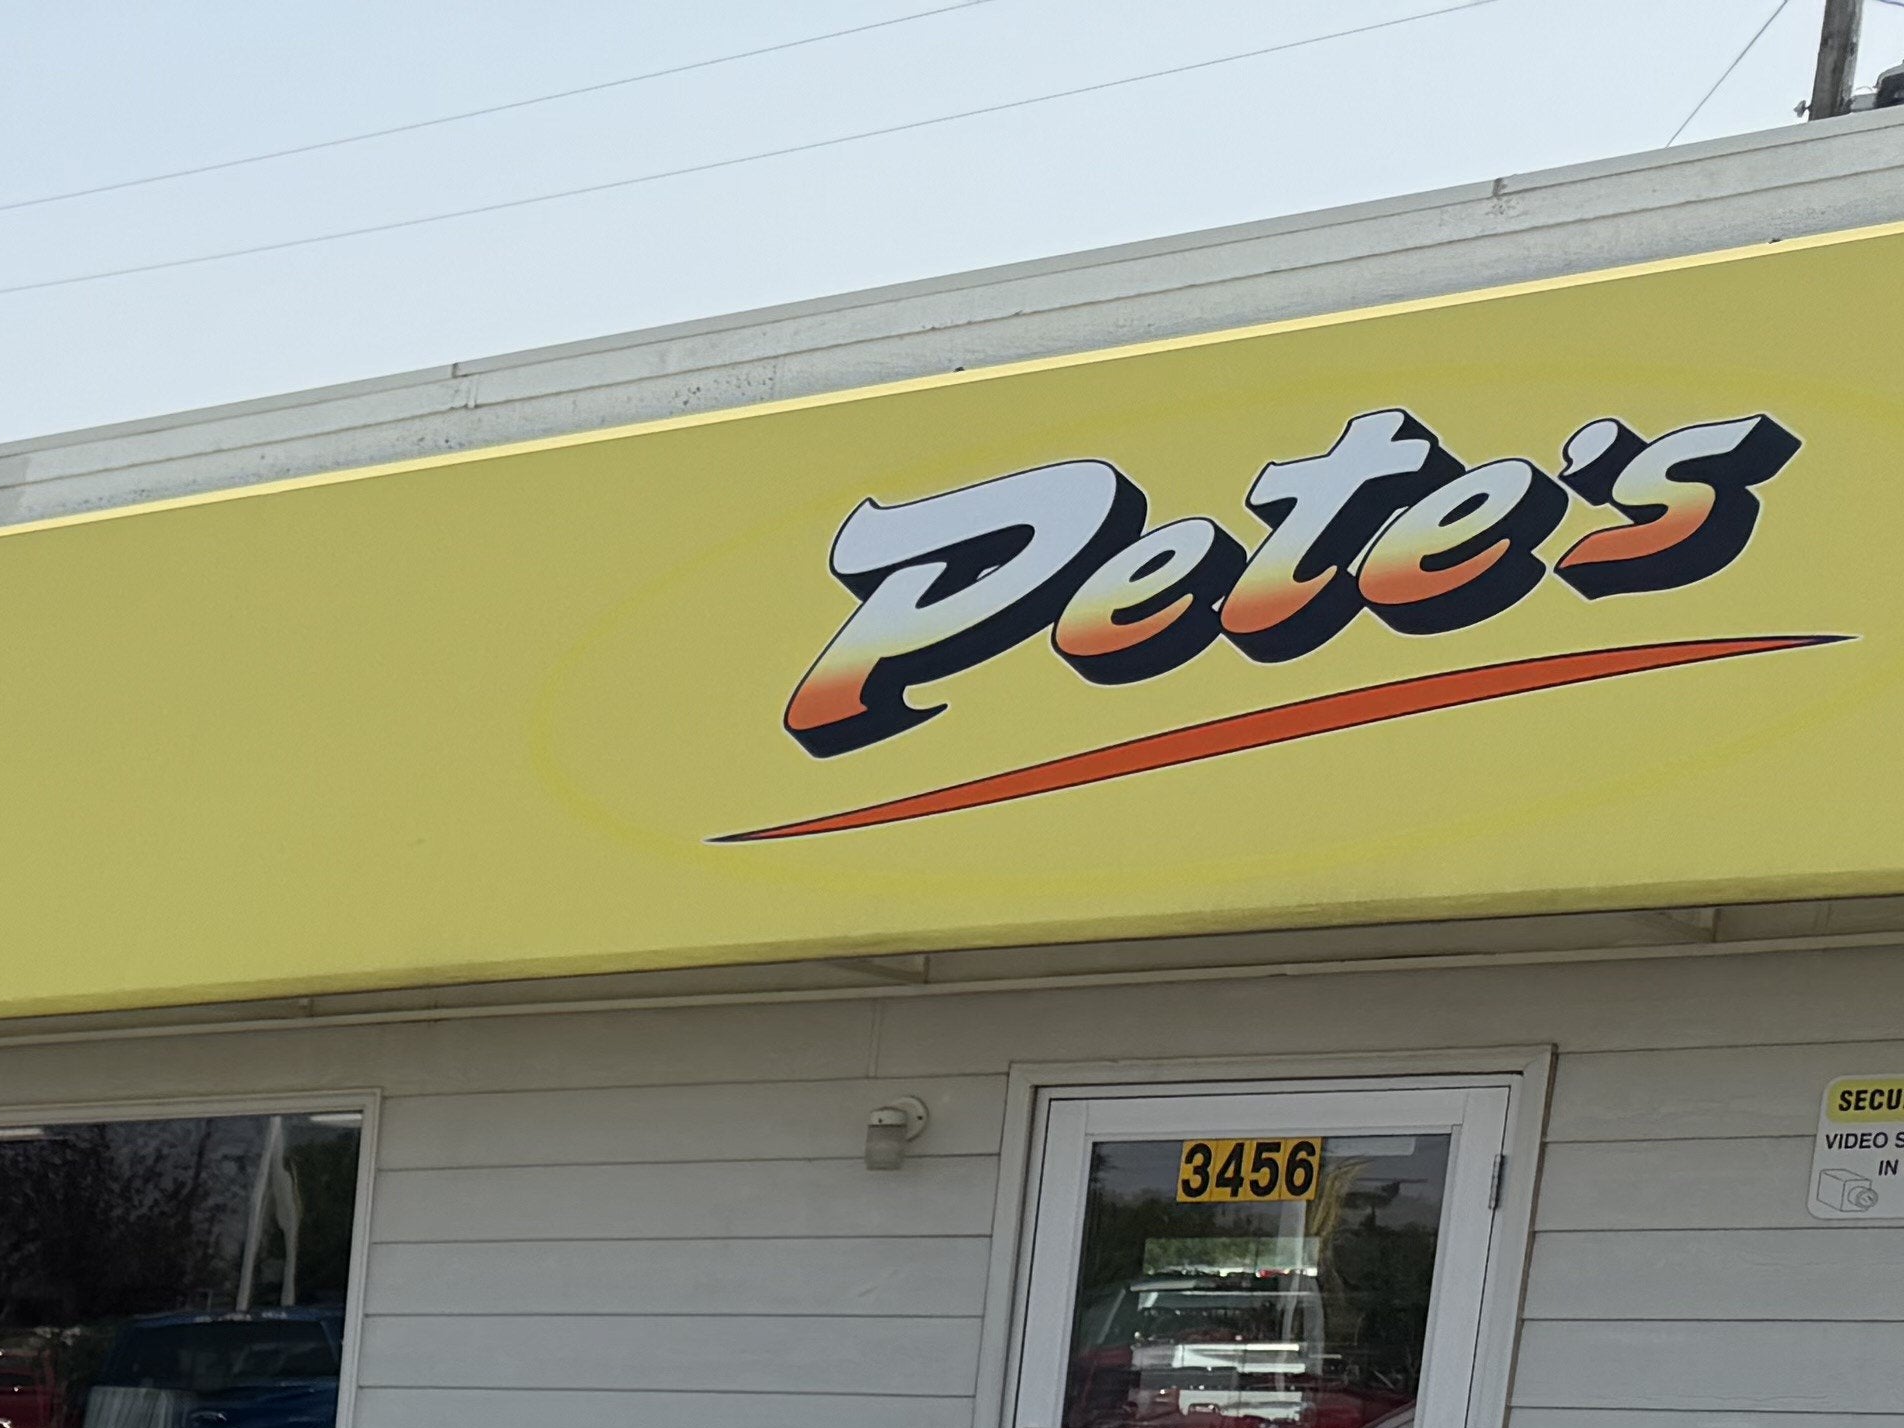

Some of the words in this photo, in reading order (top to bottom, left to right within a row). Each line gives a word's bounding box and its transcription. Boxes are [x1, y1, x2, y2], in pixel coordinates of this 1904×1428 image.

[784, 408, 1802, 758] Pete's
[1838, 1088, 1904, 1112] SECU
[1825, 1131, 1889, 1150] VIDEO
[1180, 1139, 1317, 1199] 3456
[1878, 1159, 1899, 1176] IN
